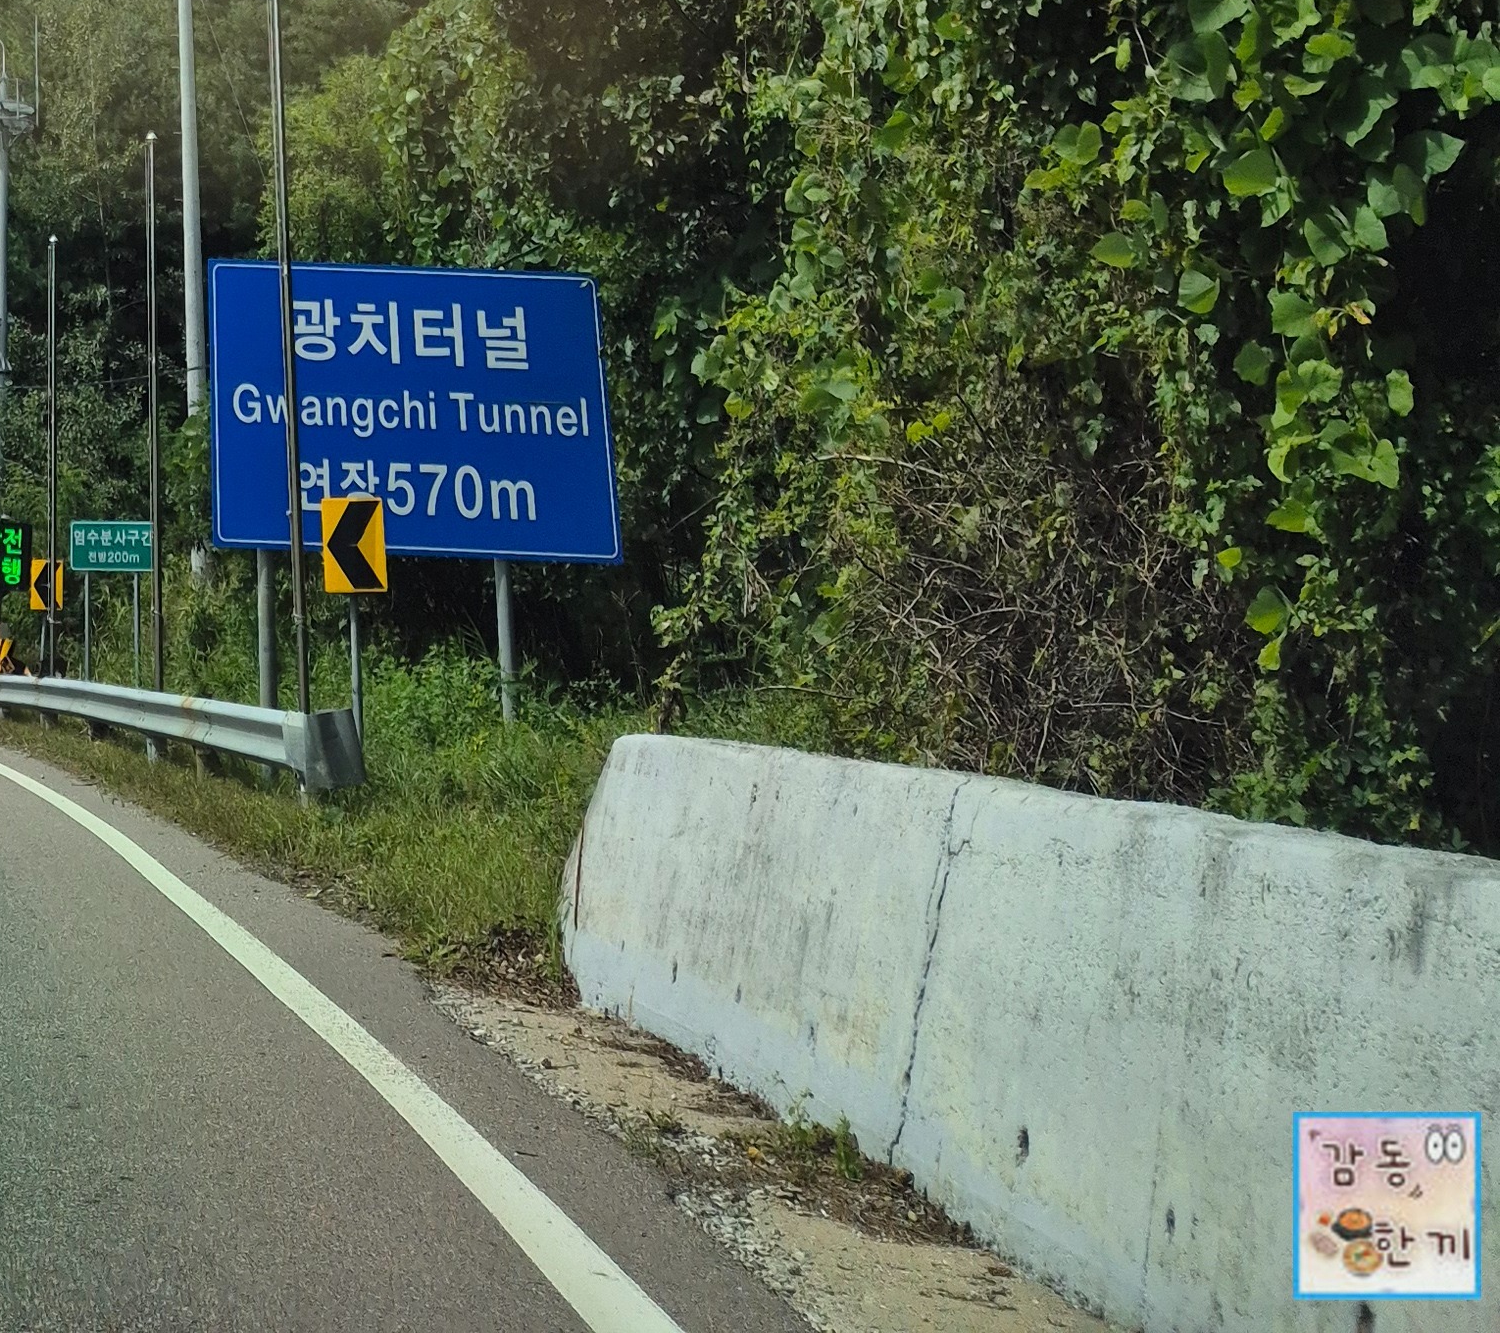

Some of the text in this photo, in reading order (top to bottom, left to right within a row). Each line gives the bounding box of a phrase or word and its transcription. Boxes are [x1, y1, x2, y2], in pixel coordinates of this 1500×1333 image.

[292, 298, 529, 370] 광치터널
[232, 383, 590, 438] Gwangchi Tunnel
